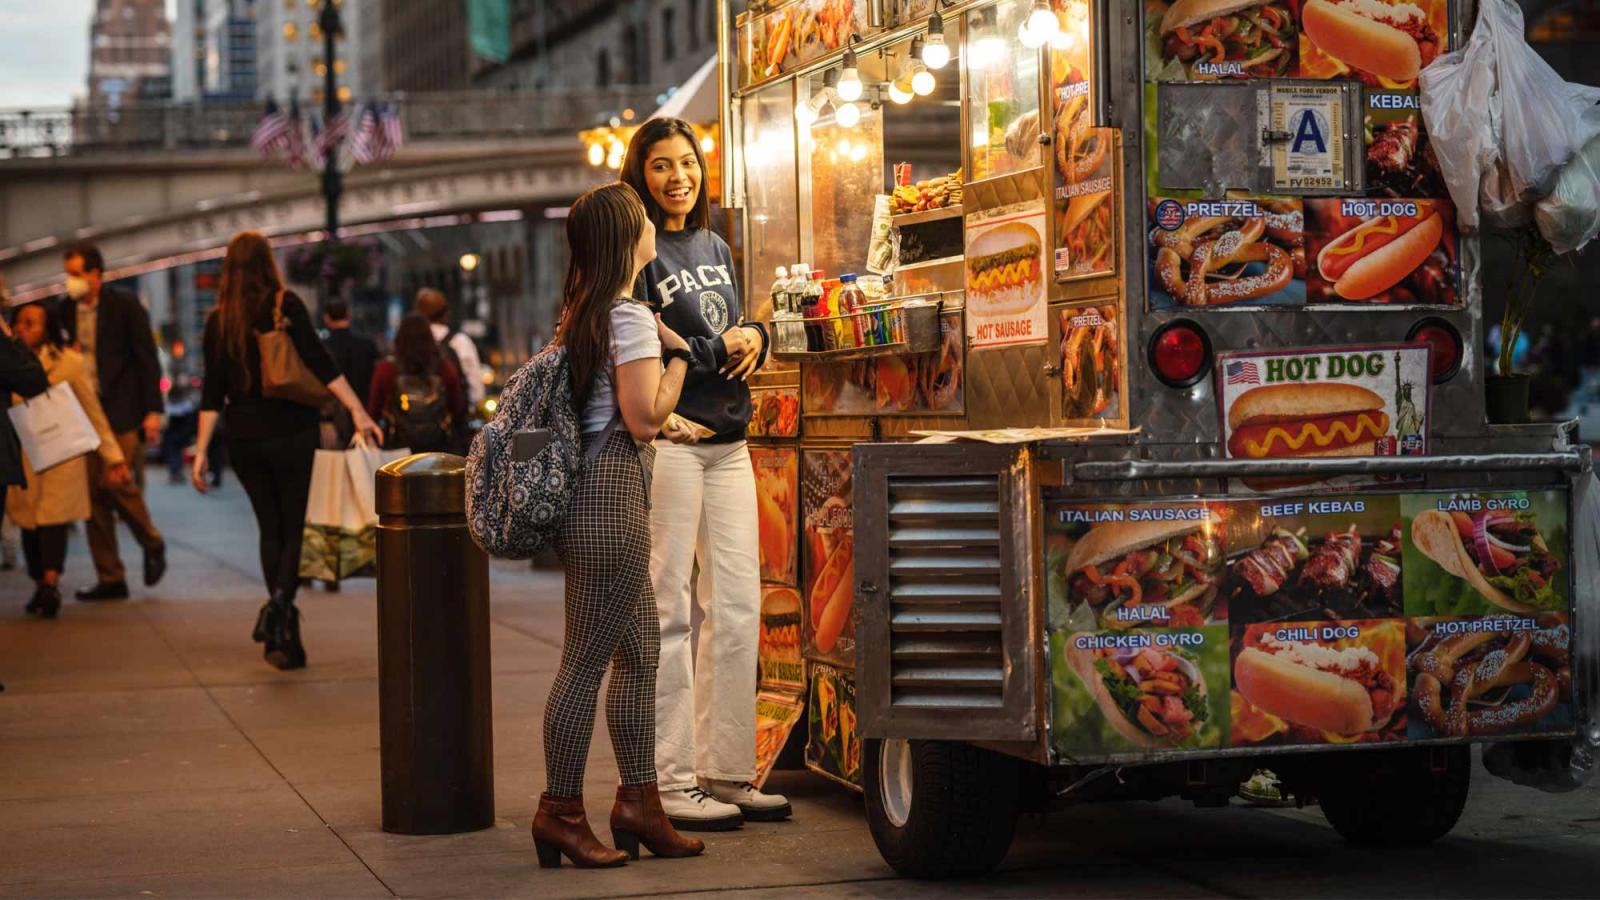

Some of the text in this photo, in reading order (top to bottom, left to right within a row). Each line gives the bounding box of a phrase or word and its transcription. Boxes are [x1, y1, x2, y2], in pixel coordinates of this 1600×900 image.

[1199, 63, 1246, 76] HALAL
[1291, 109, 1327, 153] A
[1056, 176, 1111, 200] ITALIAN SAUSAGE
[1290, 179, 1302, 187] FV
[1187, 202, 1264, 217] PRETZEL
[1342, 202, 1417, 217] HOT DOG
[976, 319, 1032, 339] HOT SAUSAGE
[1265, 352, 1385, 382] HOT DOG
[1260, 500, 1366, 517] BEEF KEBAB
[1437, 497, 1531, 512] LAMB GYRO
[1059, 508, 1211, 523] ITALIAN SAUSAGE
[1117, 607, 1171, 621] HALAL
[1275, 626, 1360, 642] CHILI DOG
[1435, 618, 1540, 634] HOT PRETZEL
[1075, 632, 1204, 650] CHICKEN GYRO
